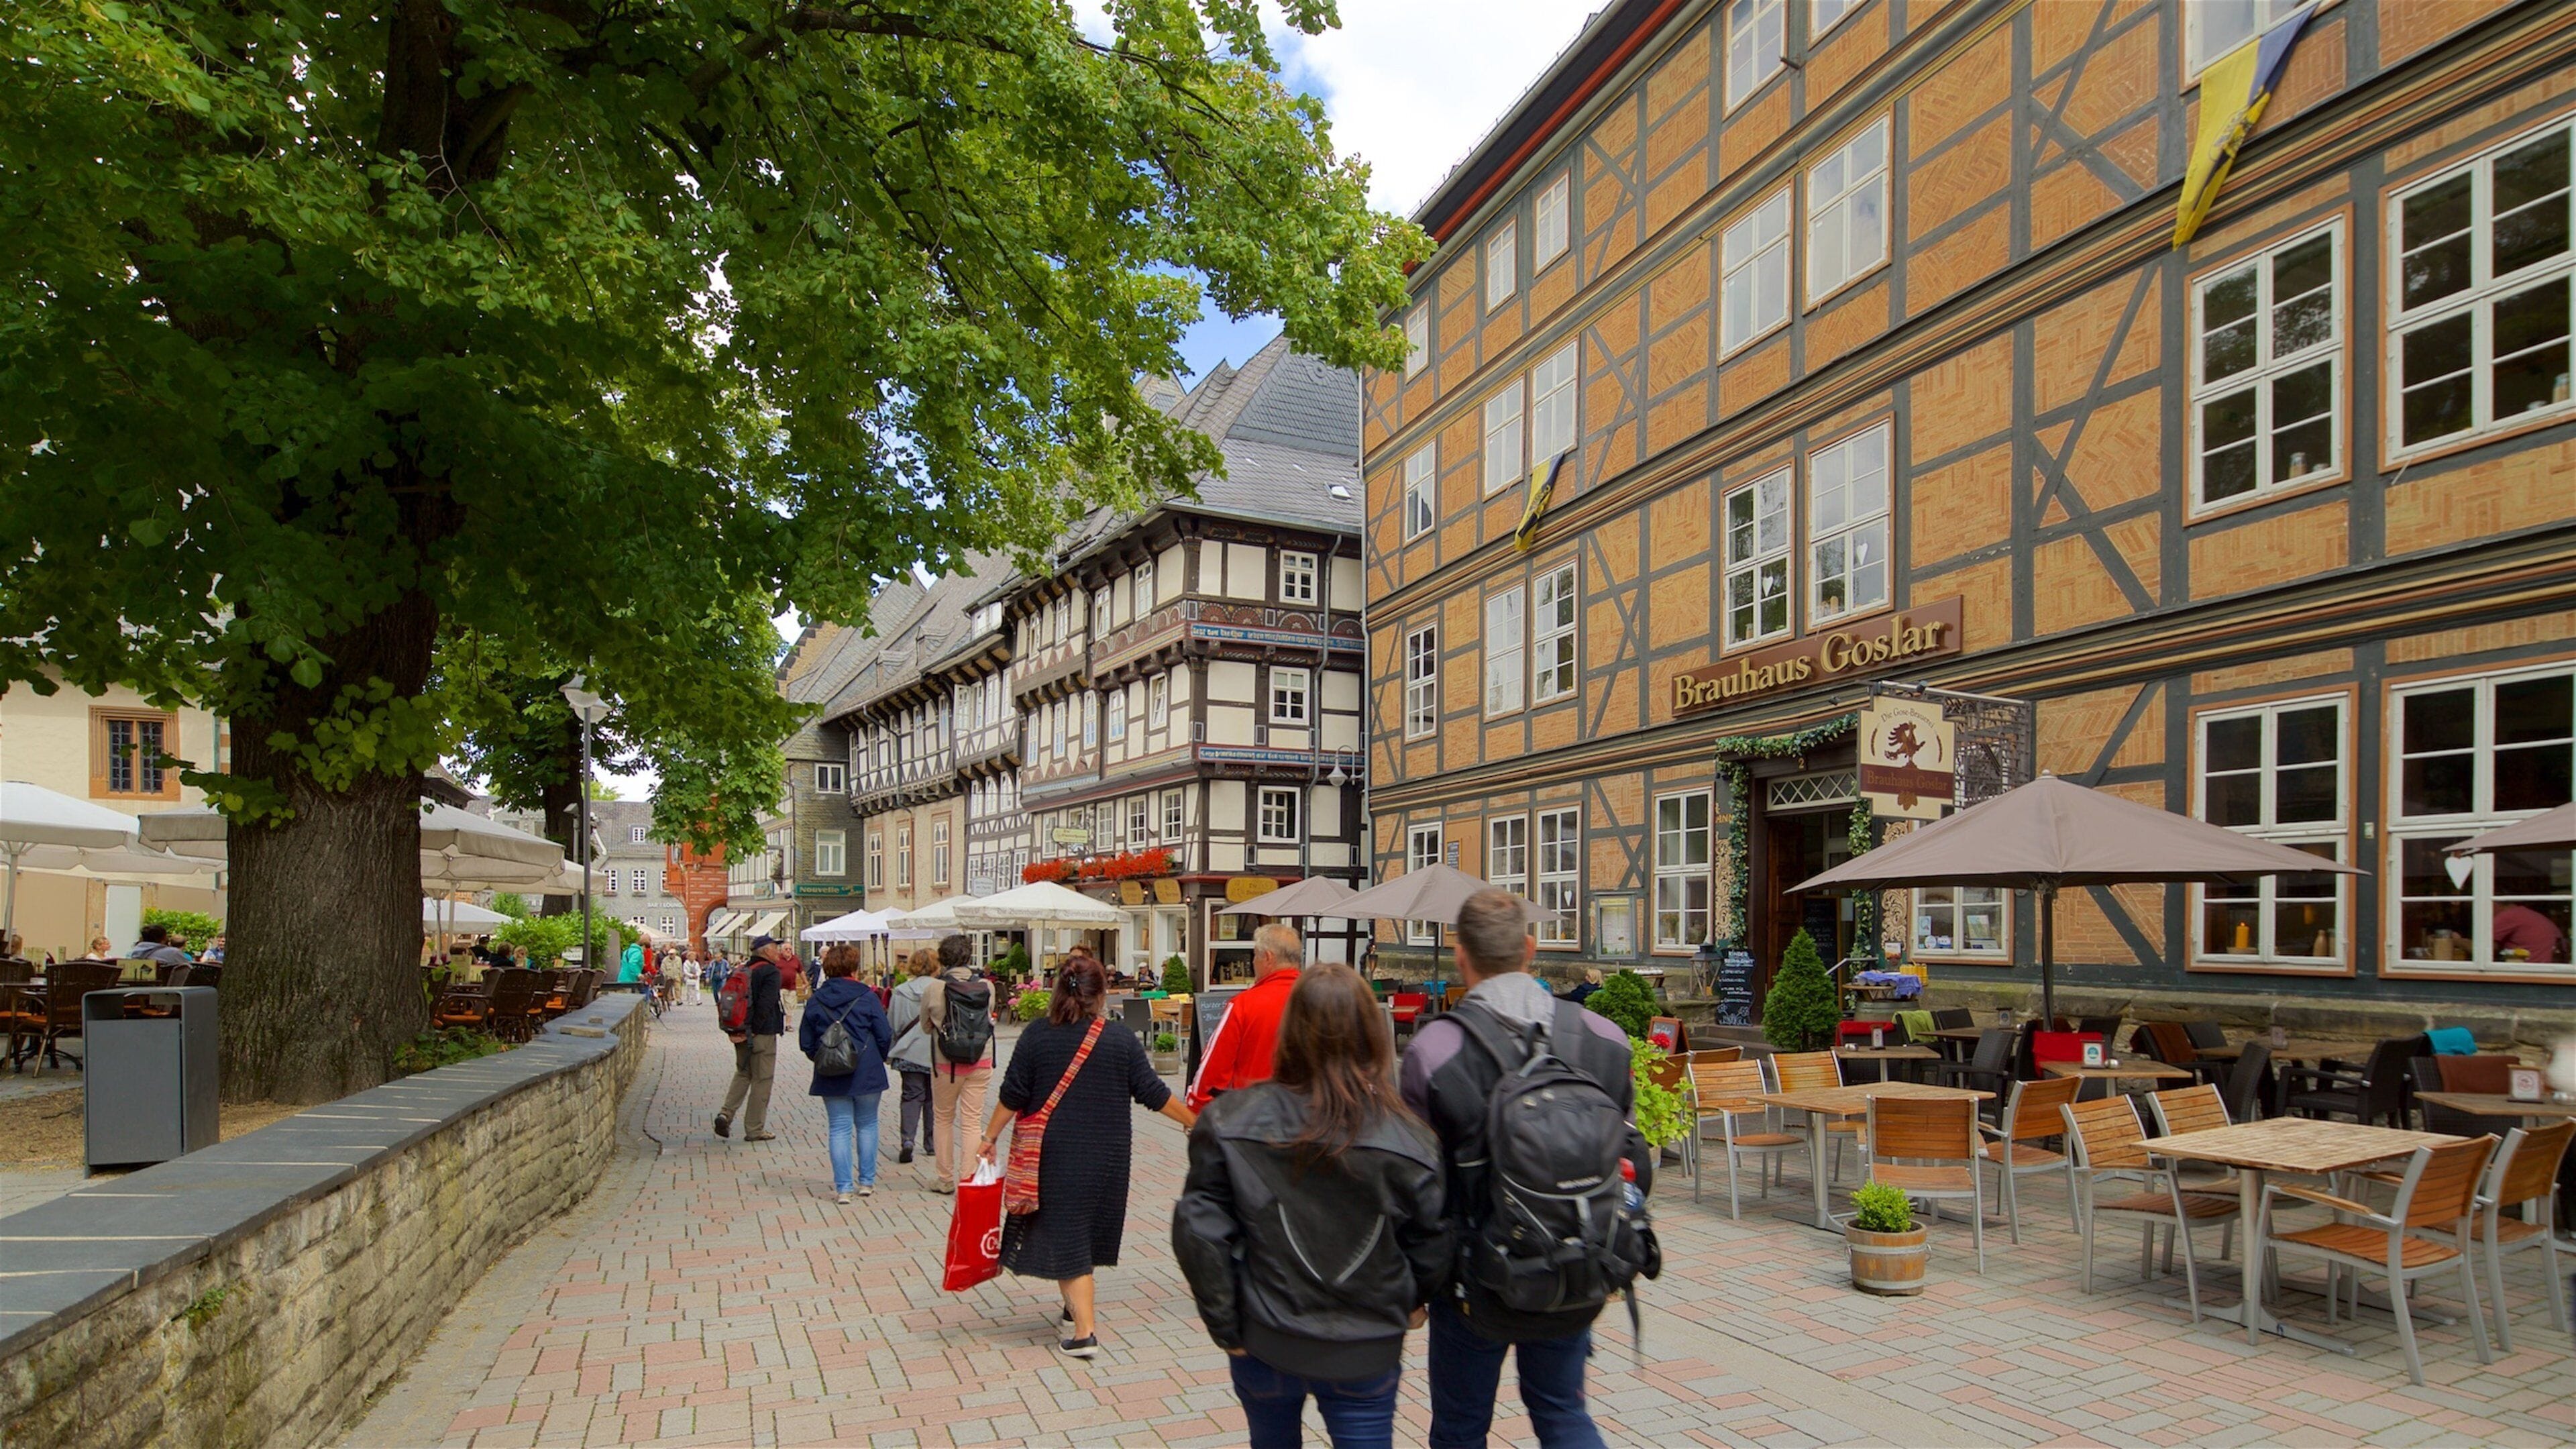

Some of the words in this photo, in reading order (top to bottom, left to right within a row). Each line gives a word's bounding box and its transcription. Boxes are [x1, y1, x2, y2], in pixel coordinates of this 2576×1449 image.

[1674, 655, 1811, 710] Brauhaus
[1820, 615, 1943, 672] Goslar
[1881, 711, 1892, 722] Die
[1798, 759, 1805, 769] 2
[1867, 770, 1914, 788] Brauhaus
[1916, 775, 1948, 791] Goslar
